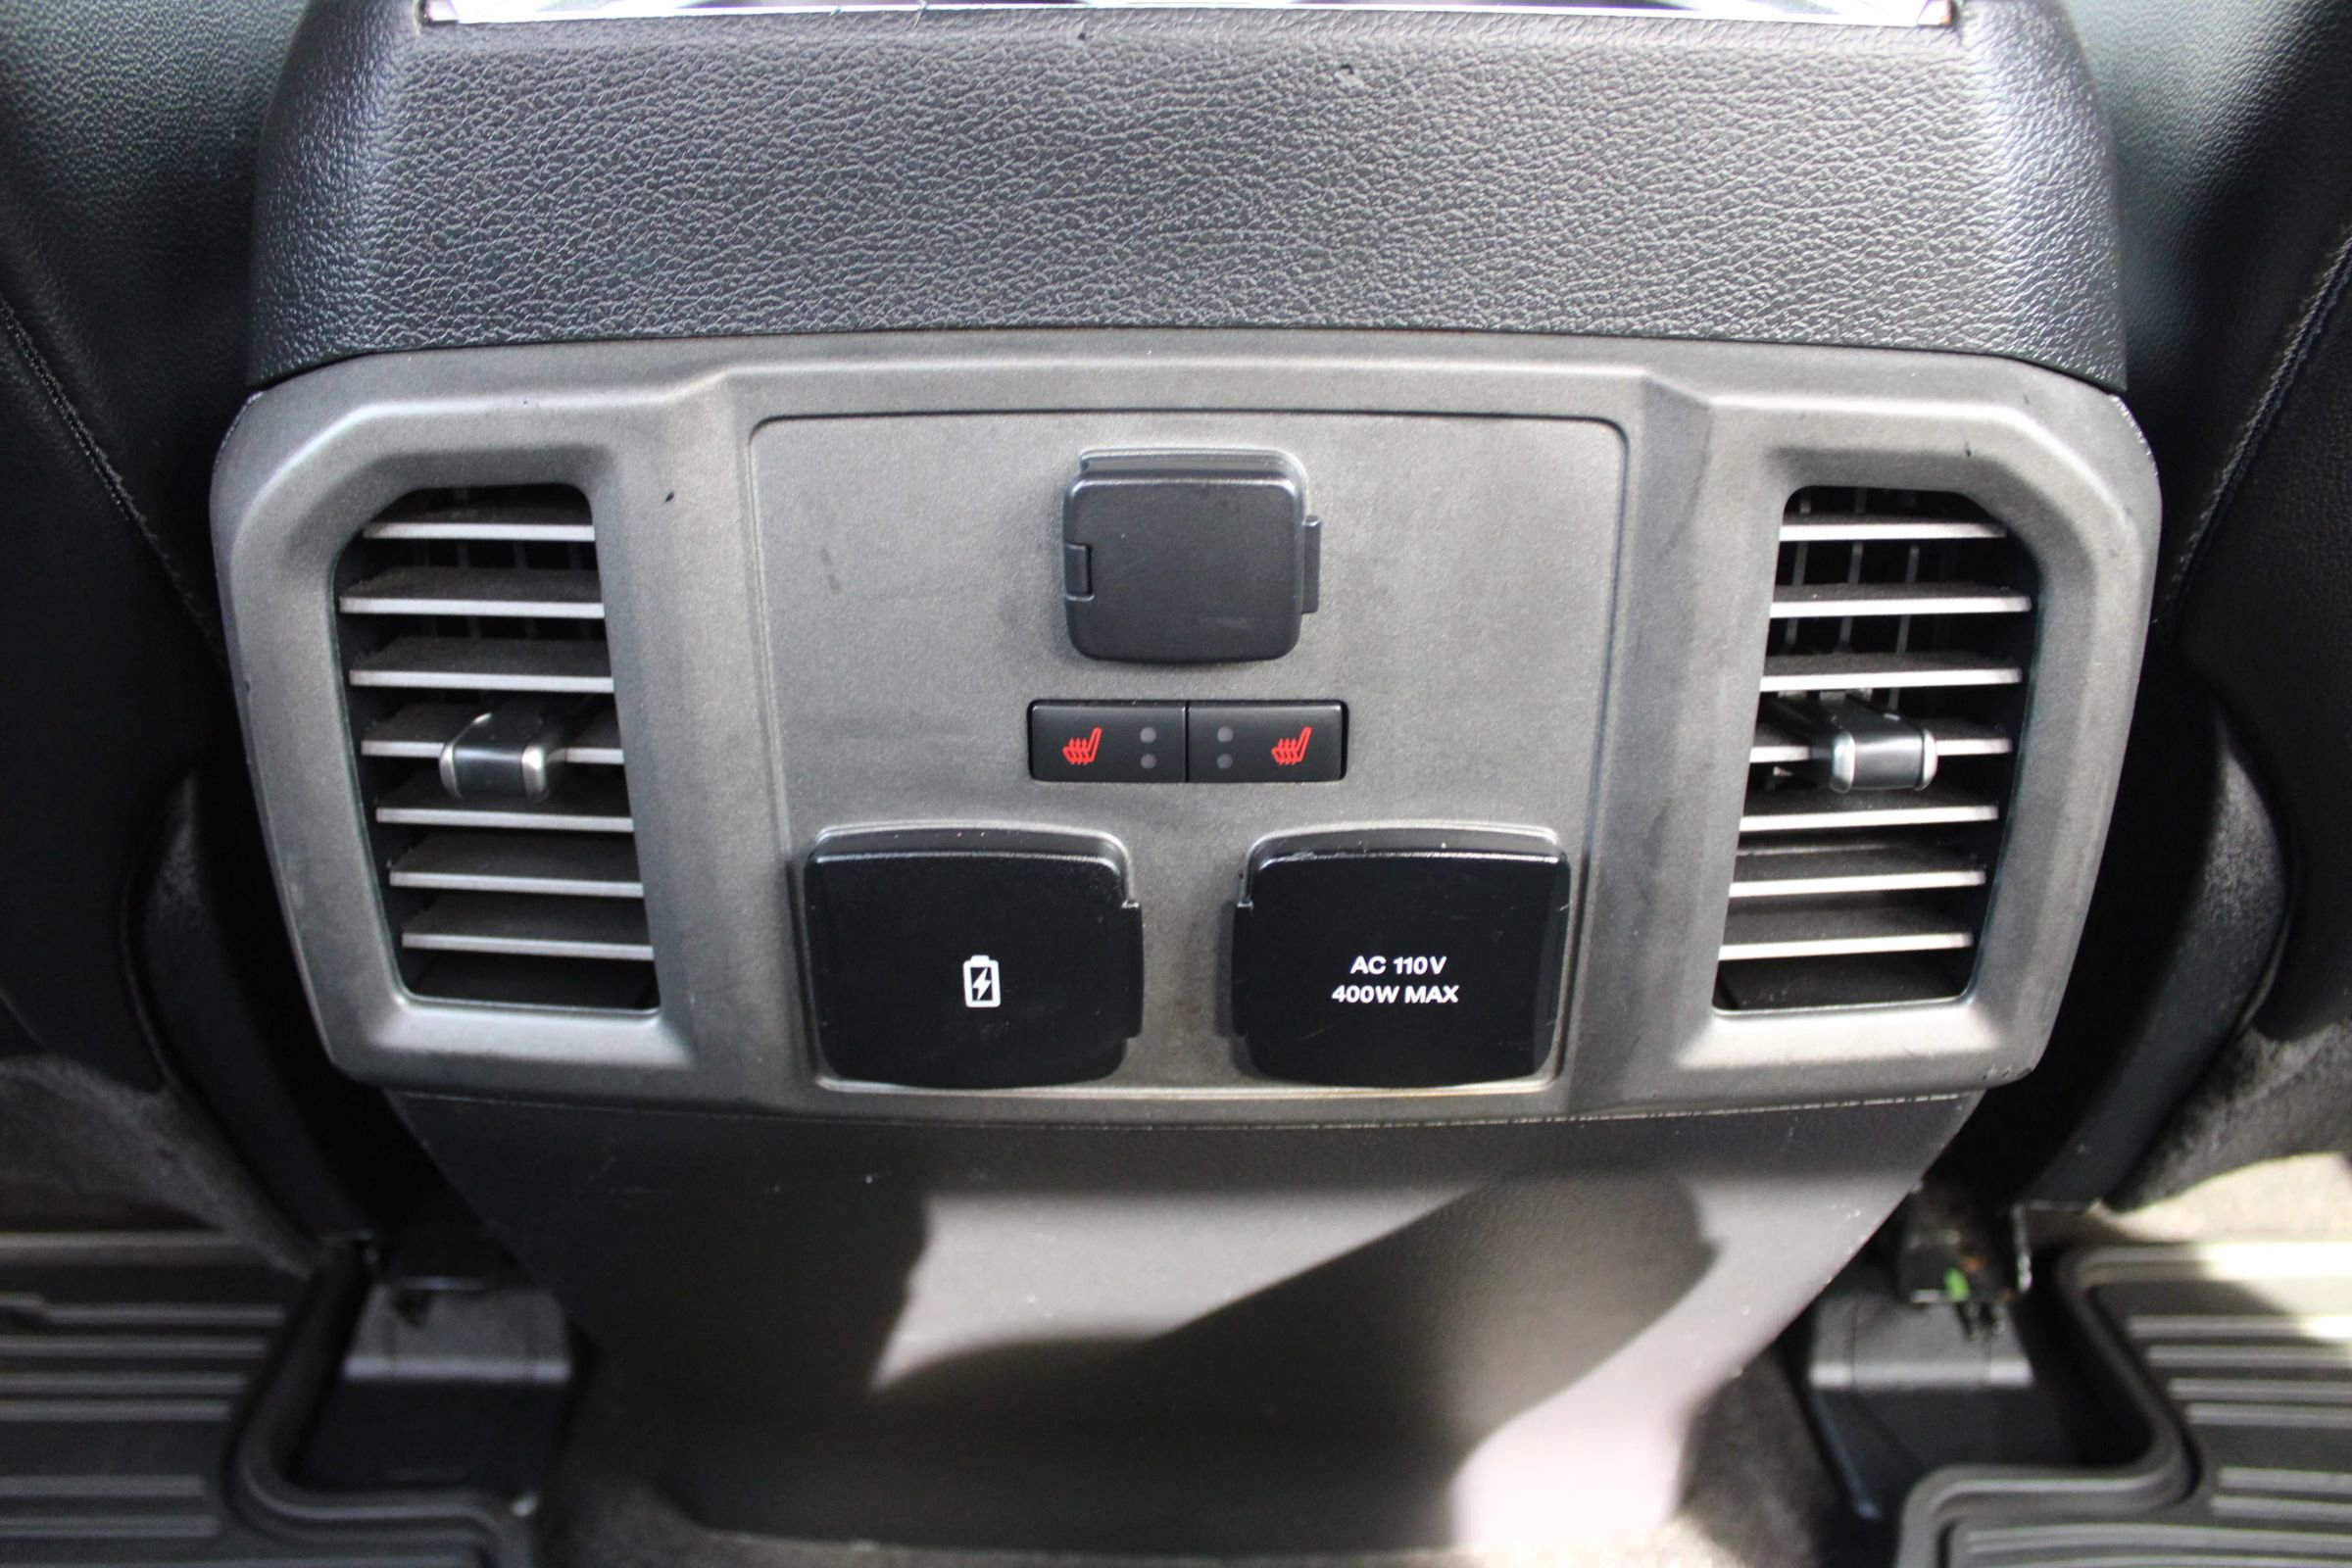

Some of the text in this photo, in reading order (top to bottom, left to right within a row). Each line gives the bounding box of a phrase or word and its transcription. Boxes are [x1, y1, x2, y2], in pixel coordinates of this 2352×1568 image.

[1349, 955, 1447, 975] AC 110V
[1331, 984, 1460, 1004] 400W MAX
